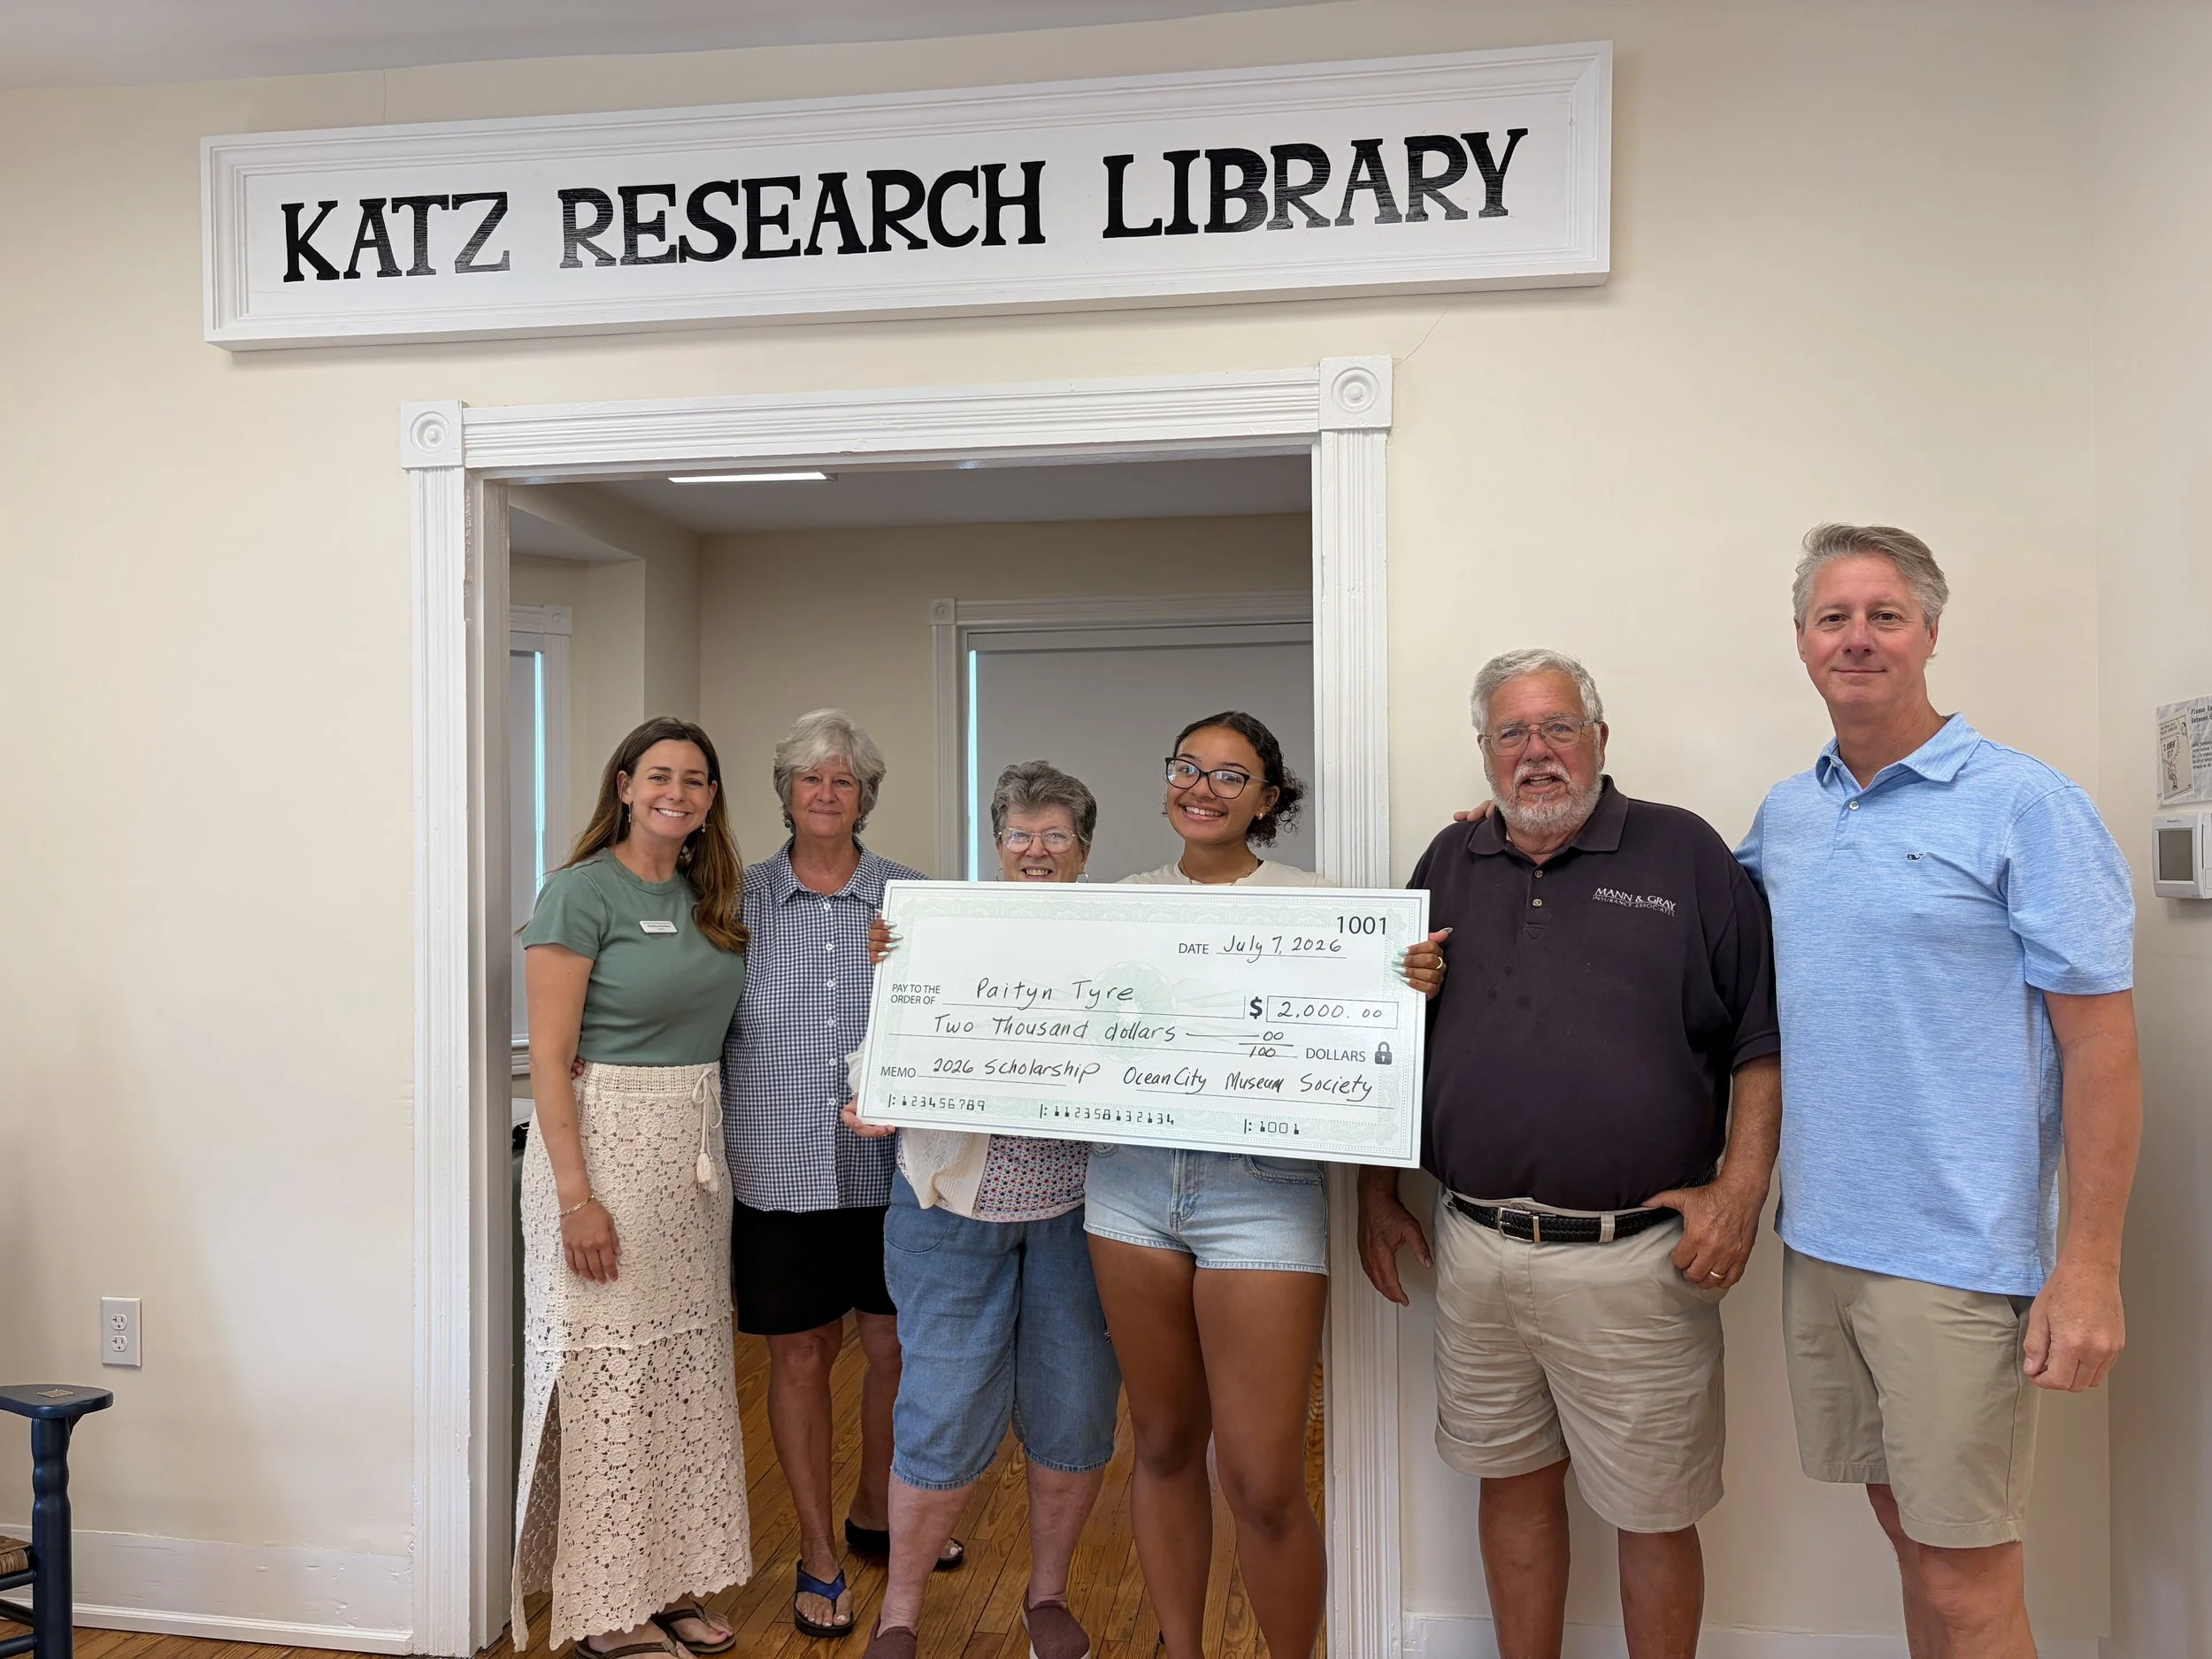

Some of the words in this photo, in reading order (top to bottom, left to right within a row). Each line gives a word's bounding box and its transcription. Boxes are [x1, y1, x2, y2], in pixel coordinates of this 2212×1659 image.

[280, 191, 511, 282] KATZ
[558, 160, 1046, 269] RESEARCH
[1102, 128, 1529, 239] LIBRARY
[1593, 895, 1632, 908] INSURANCE
[1594, 887, 1632, 902] MANN
[1647, 895, 1676, 910] GRAY
[1337, 916, 1387, 935] 1001
[1179, 942, 1209, 955] DATE
[1224, 935, 1263, 963] July
[1292, 937, 1341, 952] 2026
[892, 984, 910, 994] PAY
[910, 984, 922, 994] TO
[924, 985, 941, 995] THE
[977, 978, 1052, 1010] Paityn
[1071, 979, 1134, 1009] Tyre
[891, 995, 921, 1005] ORDER
[923, 996, 935, 1005] OF
[934, 1014, 974, 1033] Two
[993, 1016, 1089, 1039] Thousand
[1104, 1020, 1176, 1041] dollars
[1306, 1047, 1366, 1062] DOLLARS
[880, 1066, 917, 1078] MEMO
[933, 1058, 974, 1074] 2026
[1225, 1071, 1284, 1093] Museum
[1300, 1072, 1372, 1102] Society
